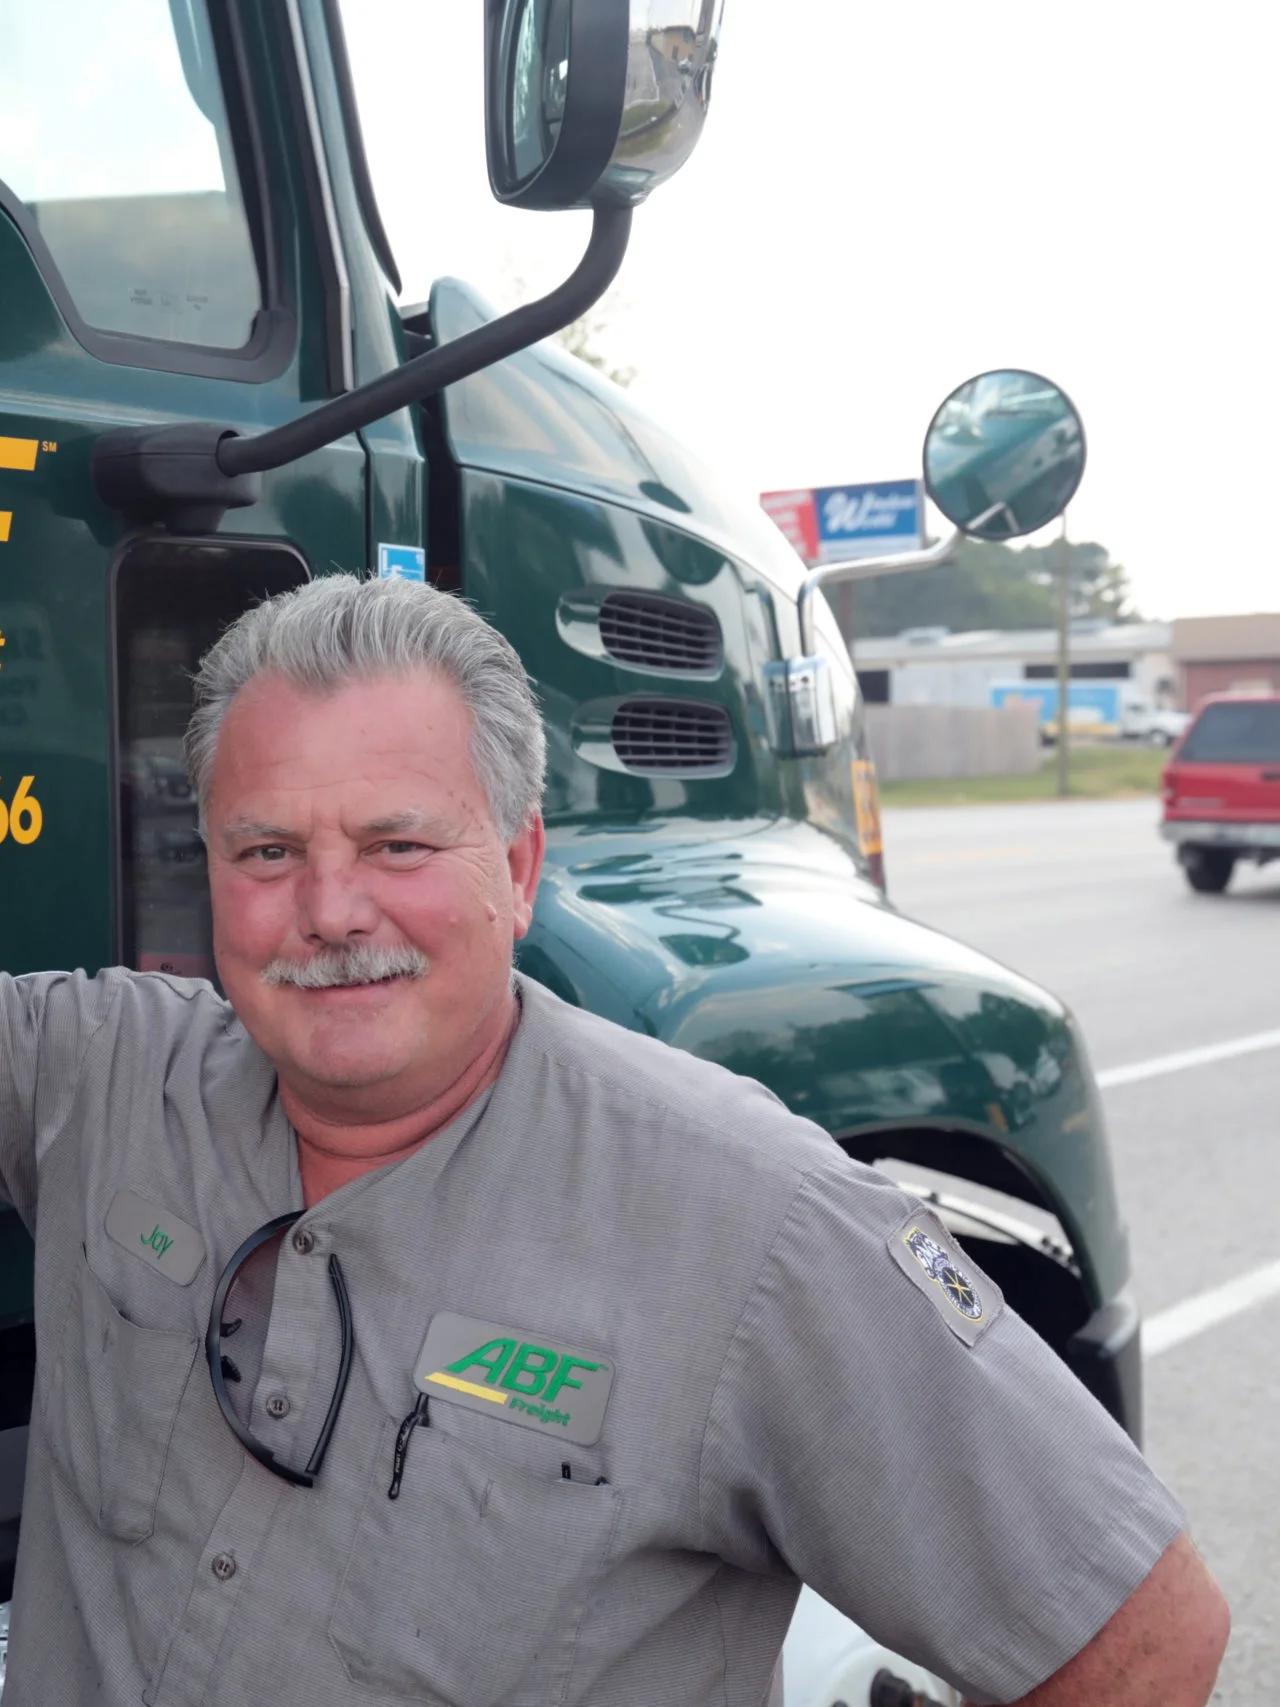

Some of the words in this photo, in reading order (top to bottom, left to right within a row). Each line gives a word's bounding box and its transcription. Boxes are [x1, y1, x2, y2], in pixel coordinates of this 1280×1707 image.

[42, 440, 57, 453] SM
[446, 1337, 600, 1403] ABF
[509, 1397, 572, 1426] Freight
